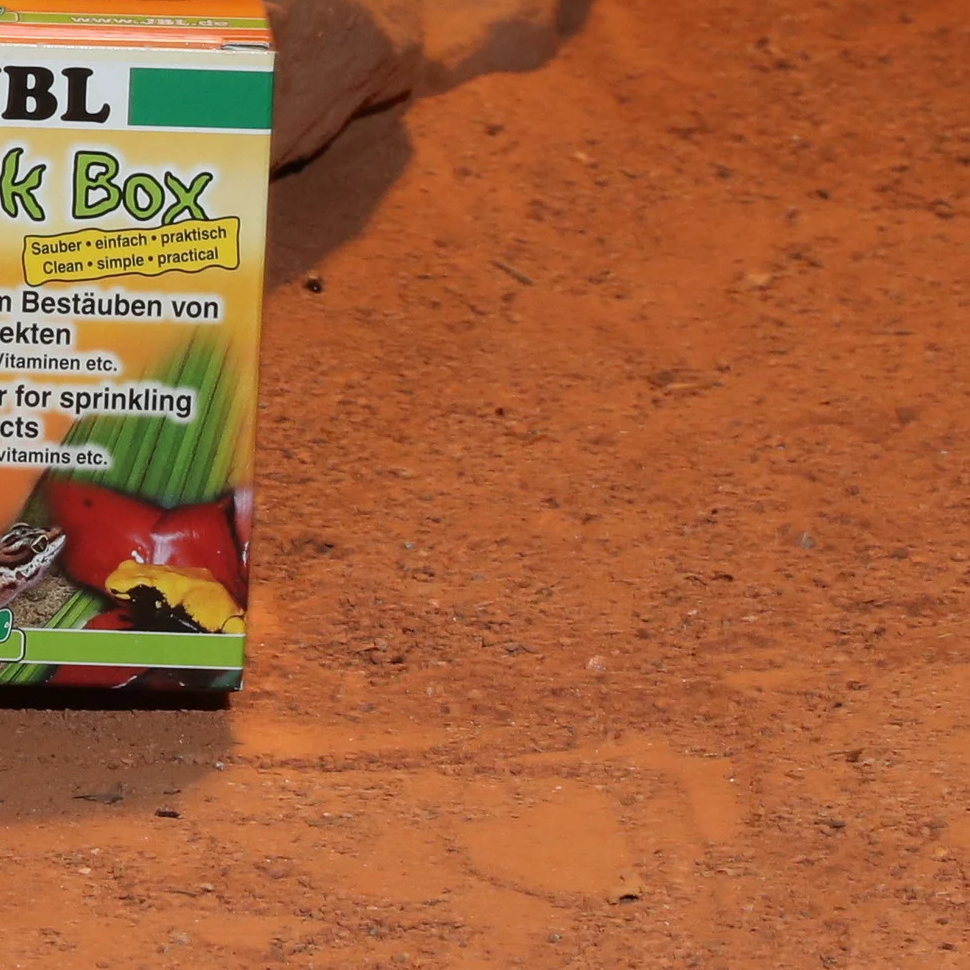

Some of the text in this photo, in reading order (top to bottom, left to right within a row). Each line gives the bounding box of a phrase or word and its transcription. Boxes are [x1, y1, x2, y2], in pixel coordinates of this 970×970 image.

[70, 16, 230, 27] www.JBL.de
[72, 150, 213, 225] Box
[31, 226, 227, 256] Sauber einfach praktisch
[42, 246, 219, 275] Clean simple practical
[22, 290, 162, 317] Bestäuben
[171, 298, 219, 319] von
[86, 356, 118, 373] etc.
[15, 383, 51, 408] for
[59, 387, 193, 418] sprinkling
[76, 449, 108, 467] etc.
